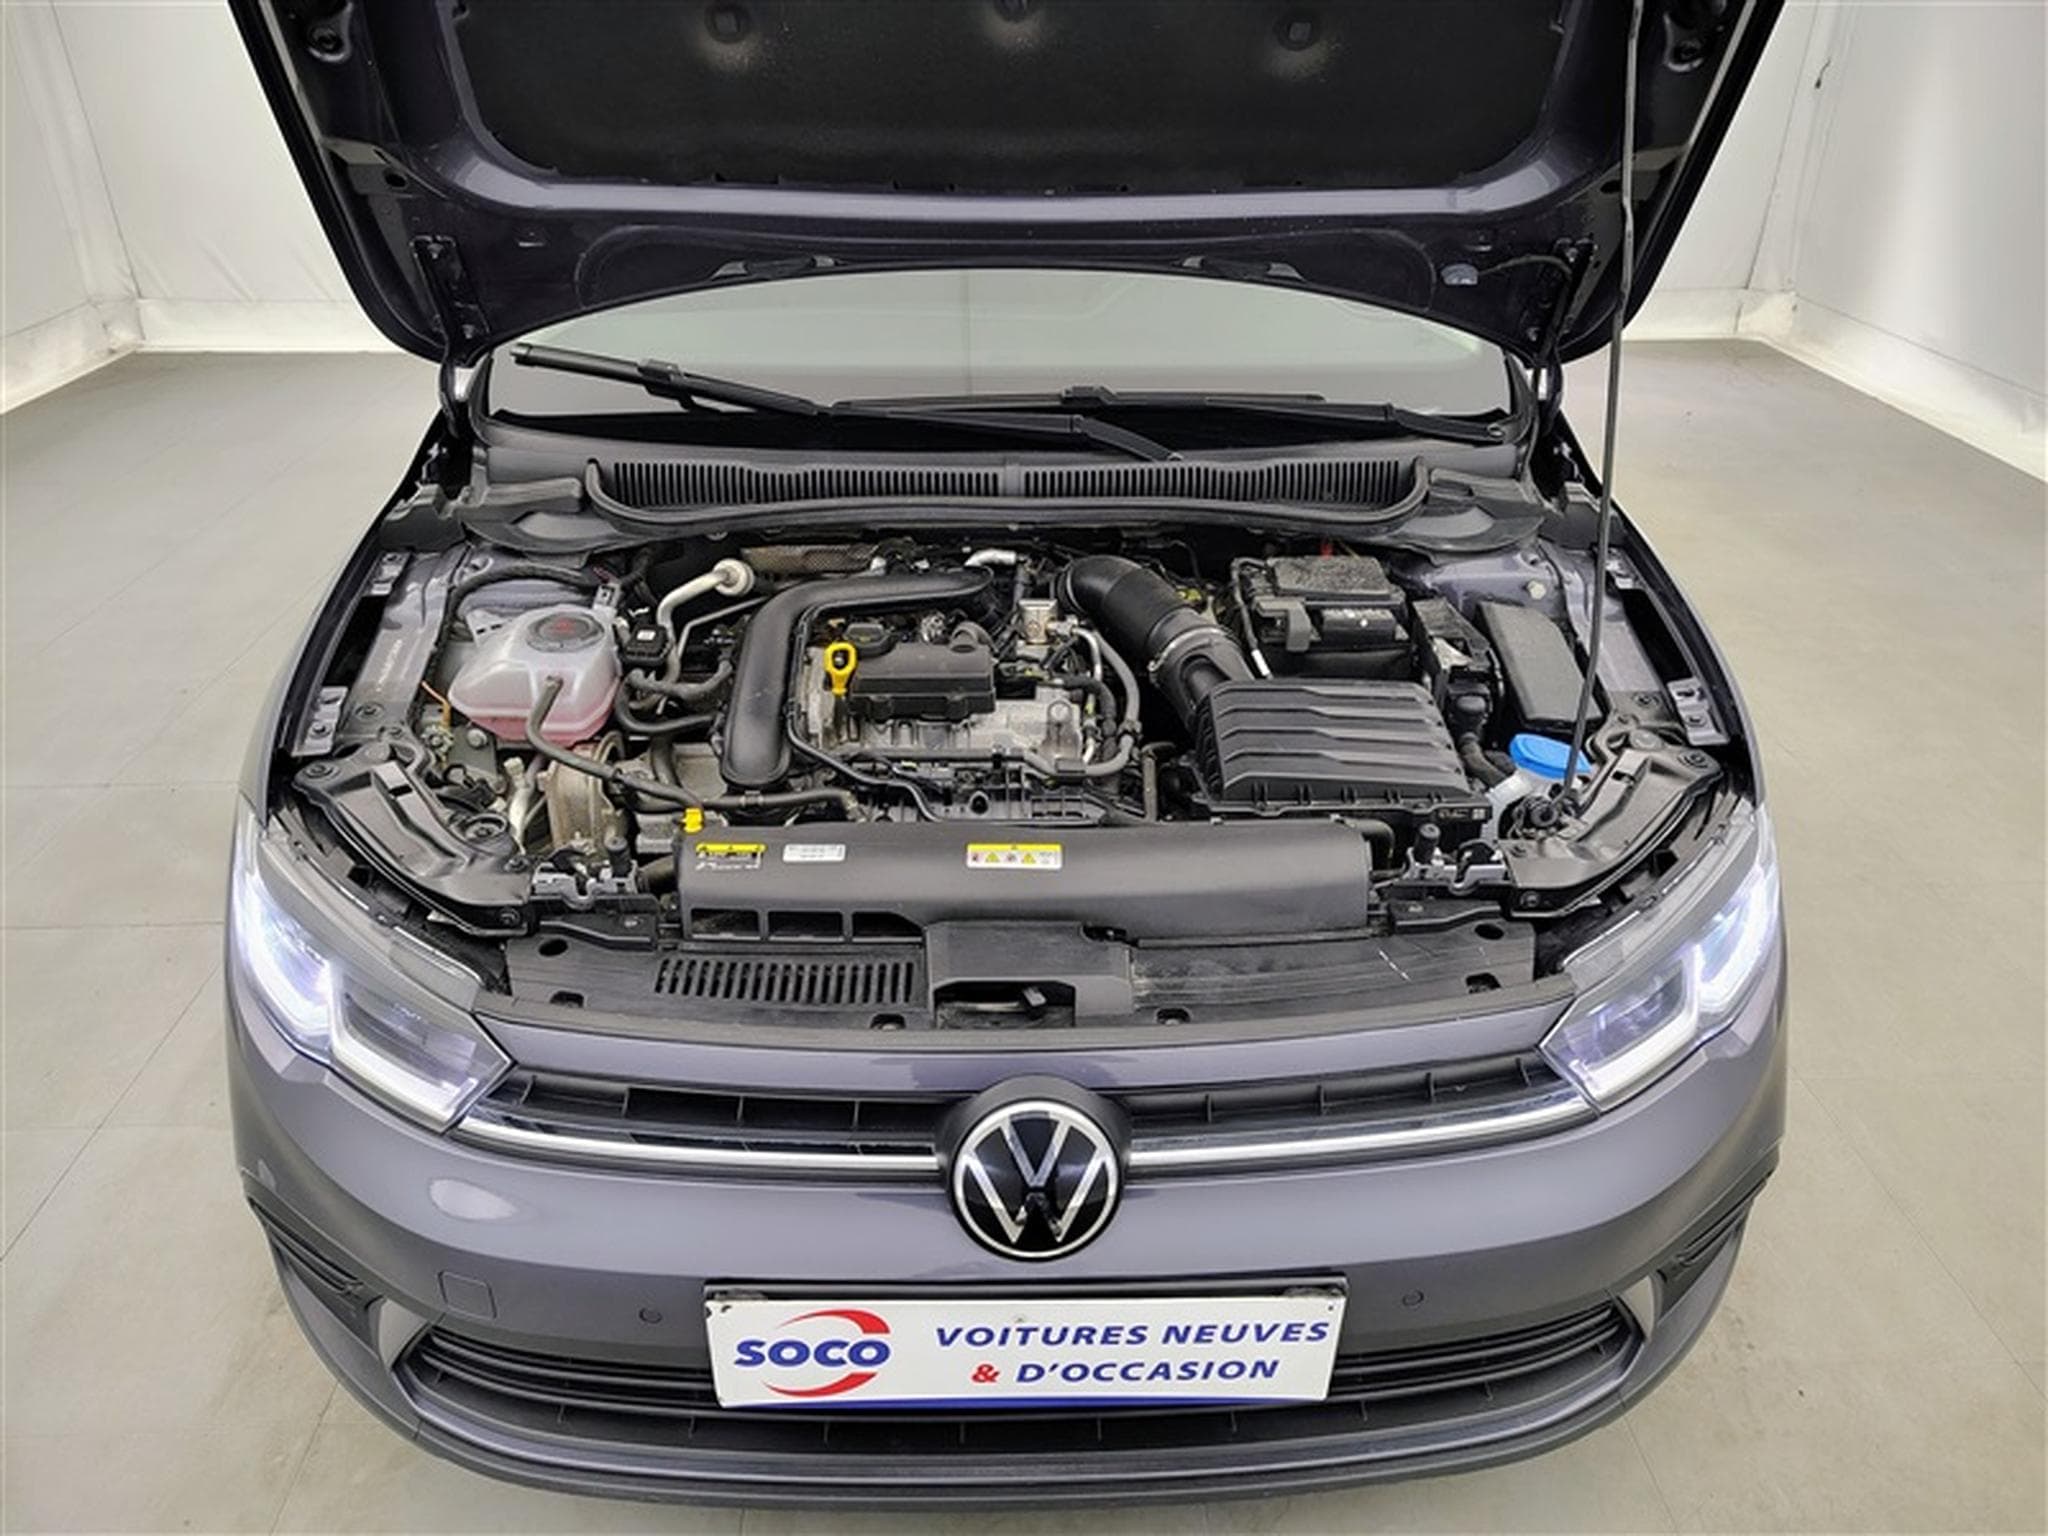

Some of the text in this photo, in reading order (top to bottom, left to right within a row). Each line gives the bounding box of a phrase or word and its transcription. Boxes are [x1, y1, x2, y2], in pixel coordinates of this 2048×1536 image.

[936, 1321, 1330, 1347] VOITURES NEUVES
[734, 1338, 892, 1368] SOCO
[971, 1359, 1279, 1383] & D'OCCASION
